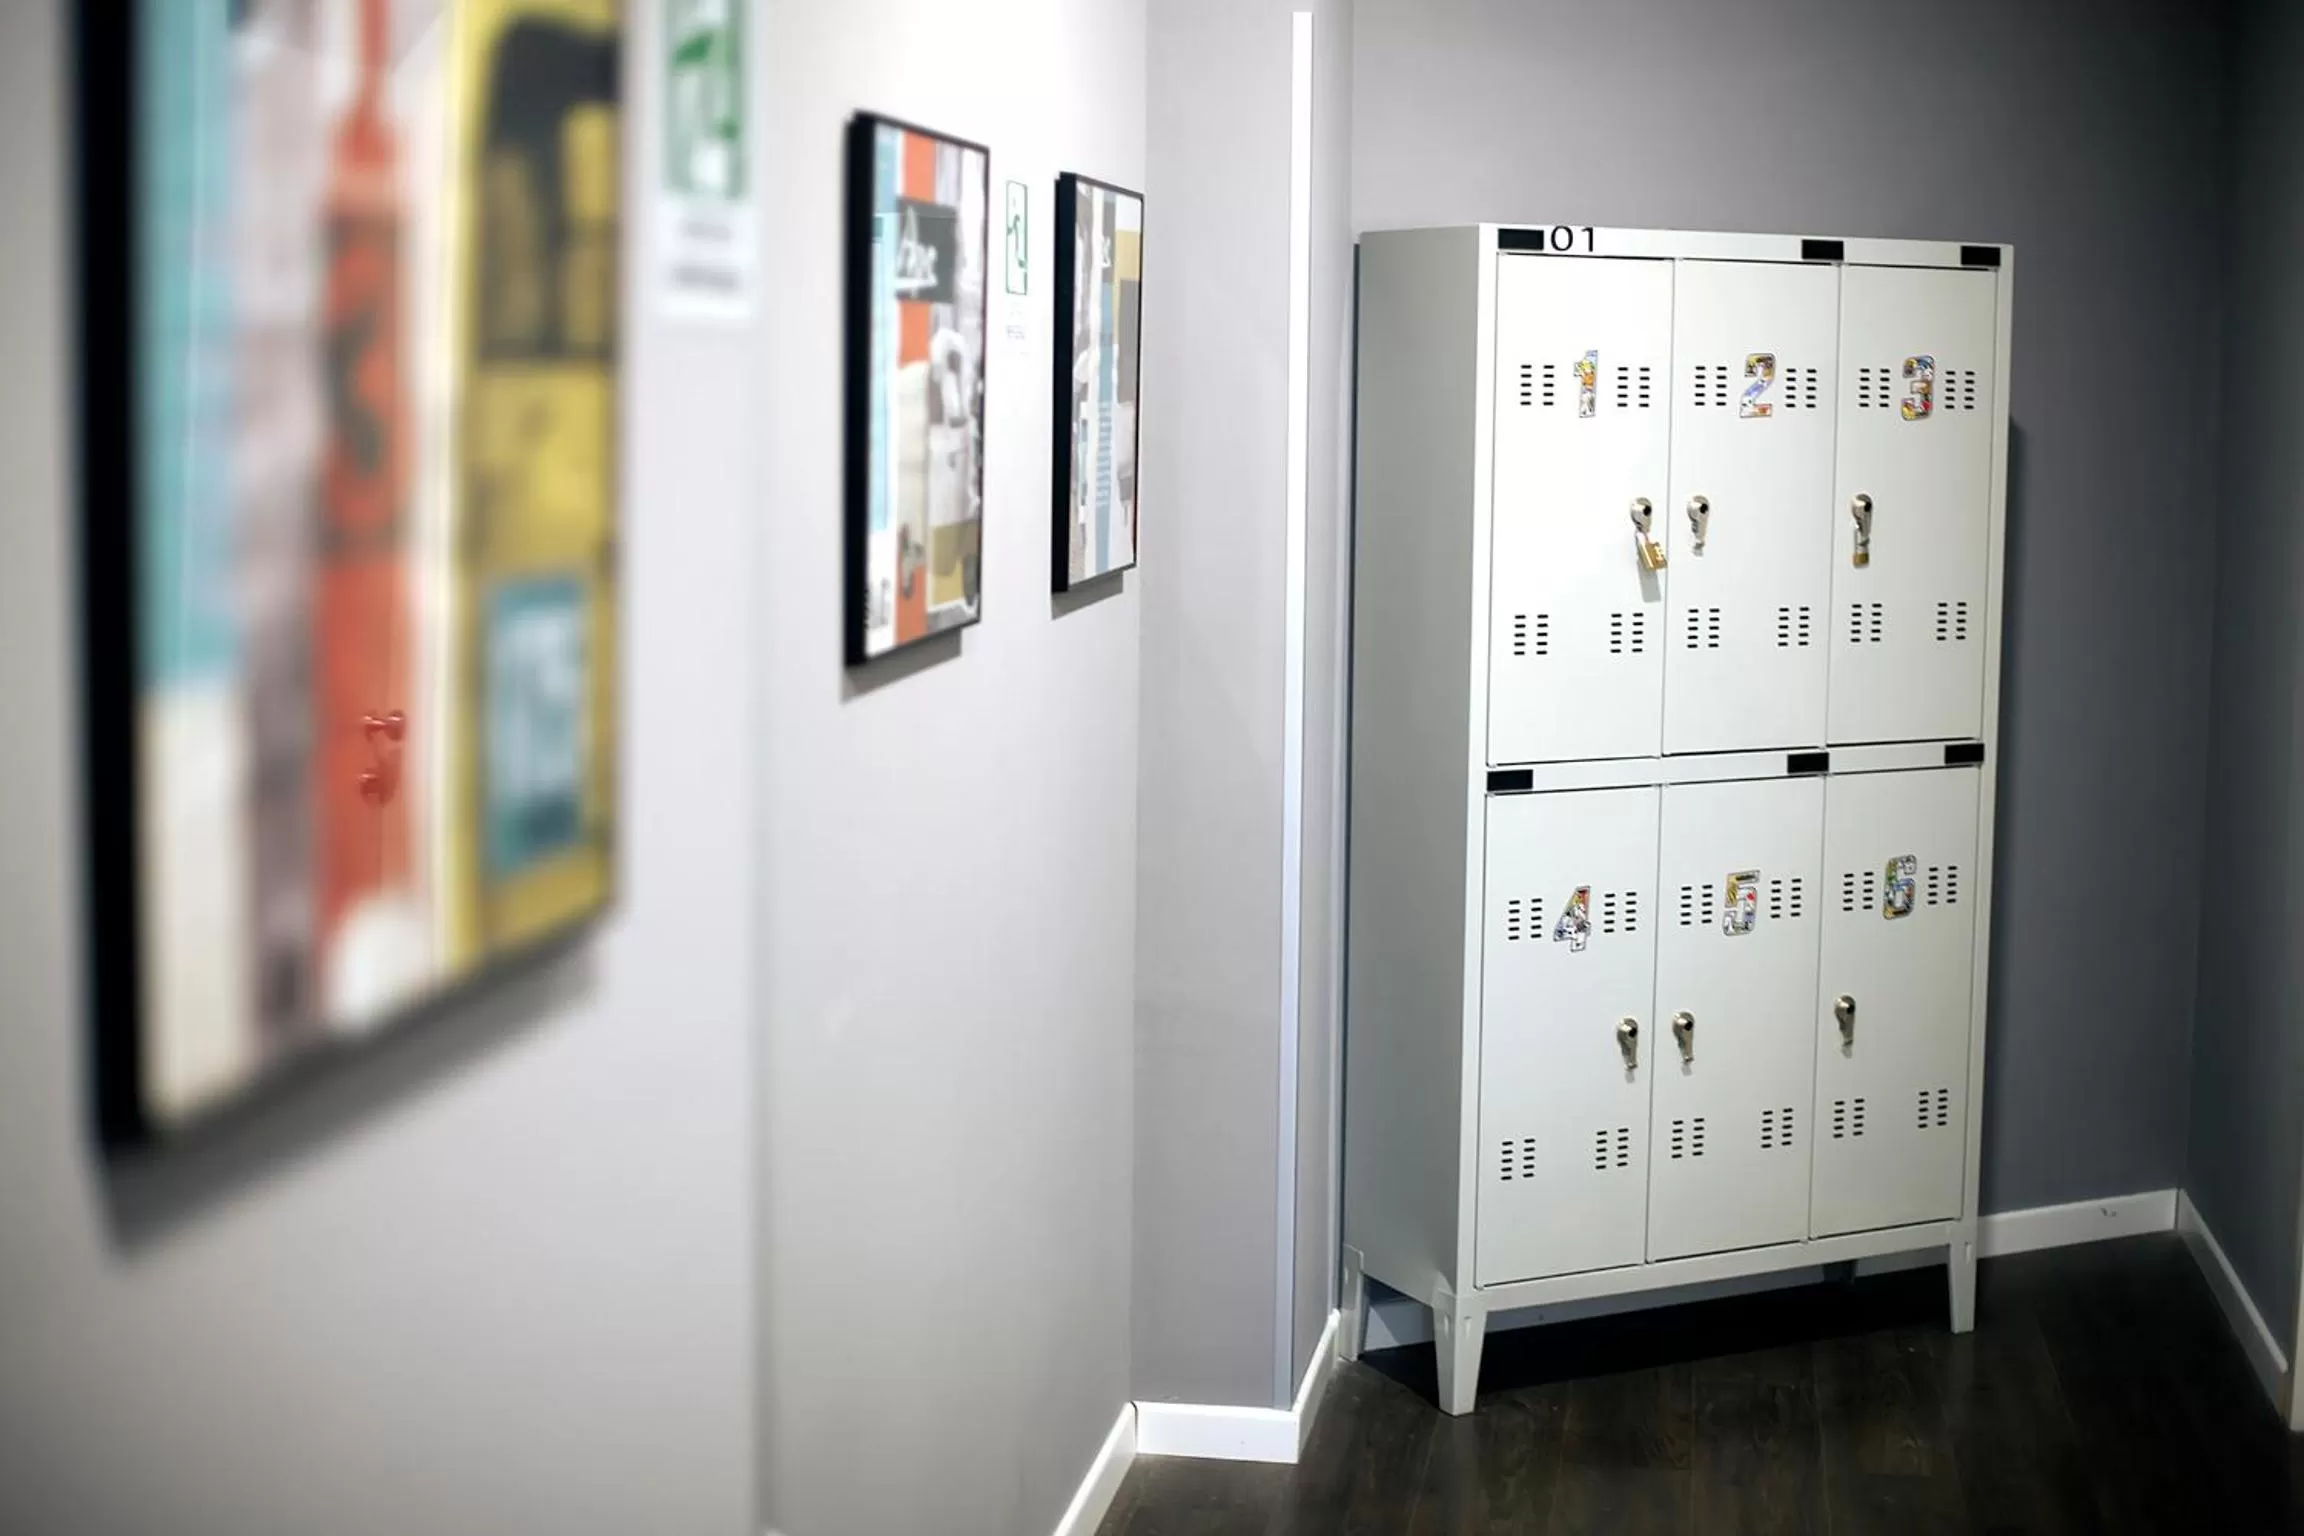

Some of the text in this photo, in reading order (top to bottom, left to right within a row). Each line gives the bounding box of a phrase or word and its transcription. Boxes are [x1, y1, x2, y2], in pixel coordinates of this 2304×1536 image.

[1551, 225, 1594, 252] 01
[1574, 350, 1598, 417] 1
[1739, 353, 1776, 418] 2
[1901, 355, 1936, 421] 3
[1553, 885, 1591, 952] 4
[1723, 869, 1760, 936] 5
[1882, 854, 1917, 920] 6
